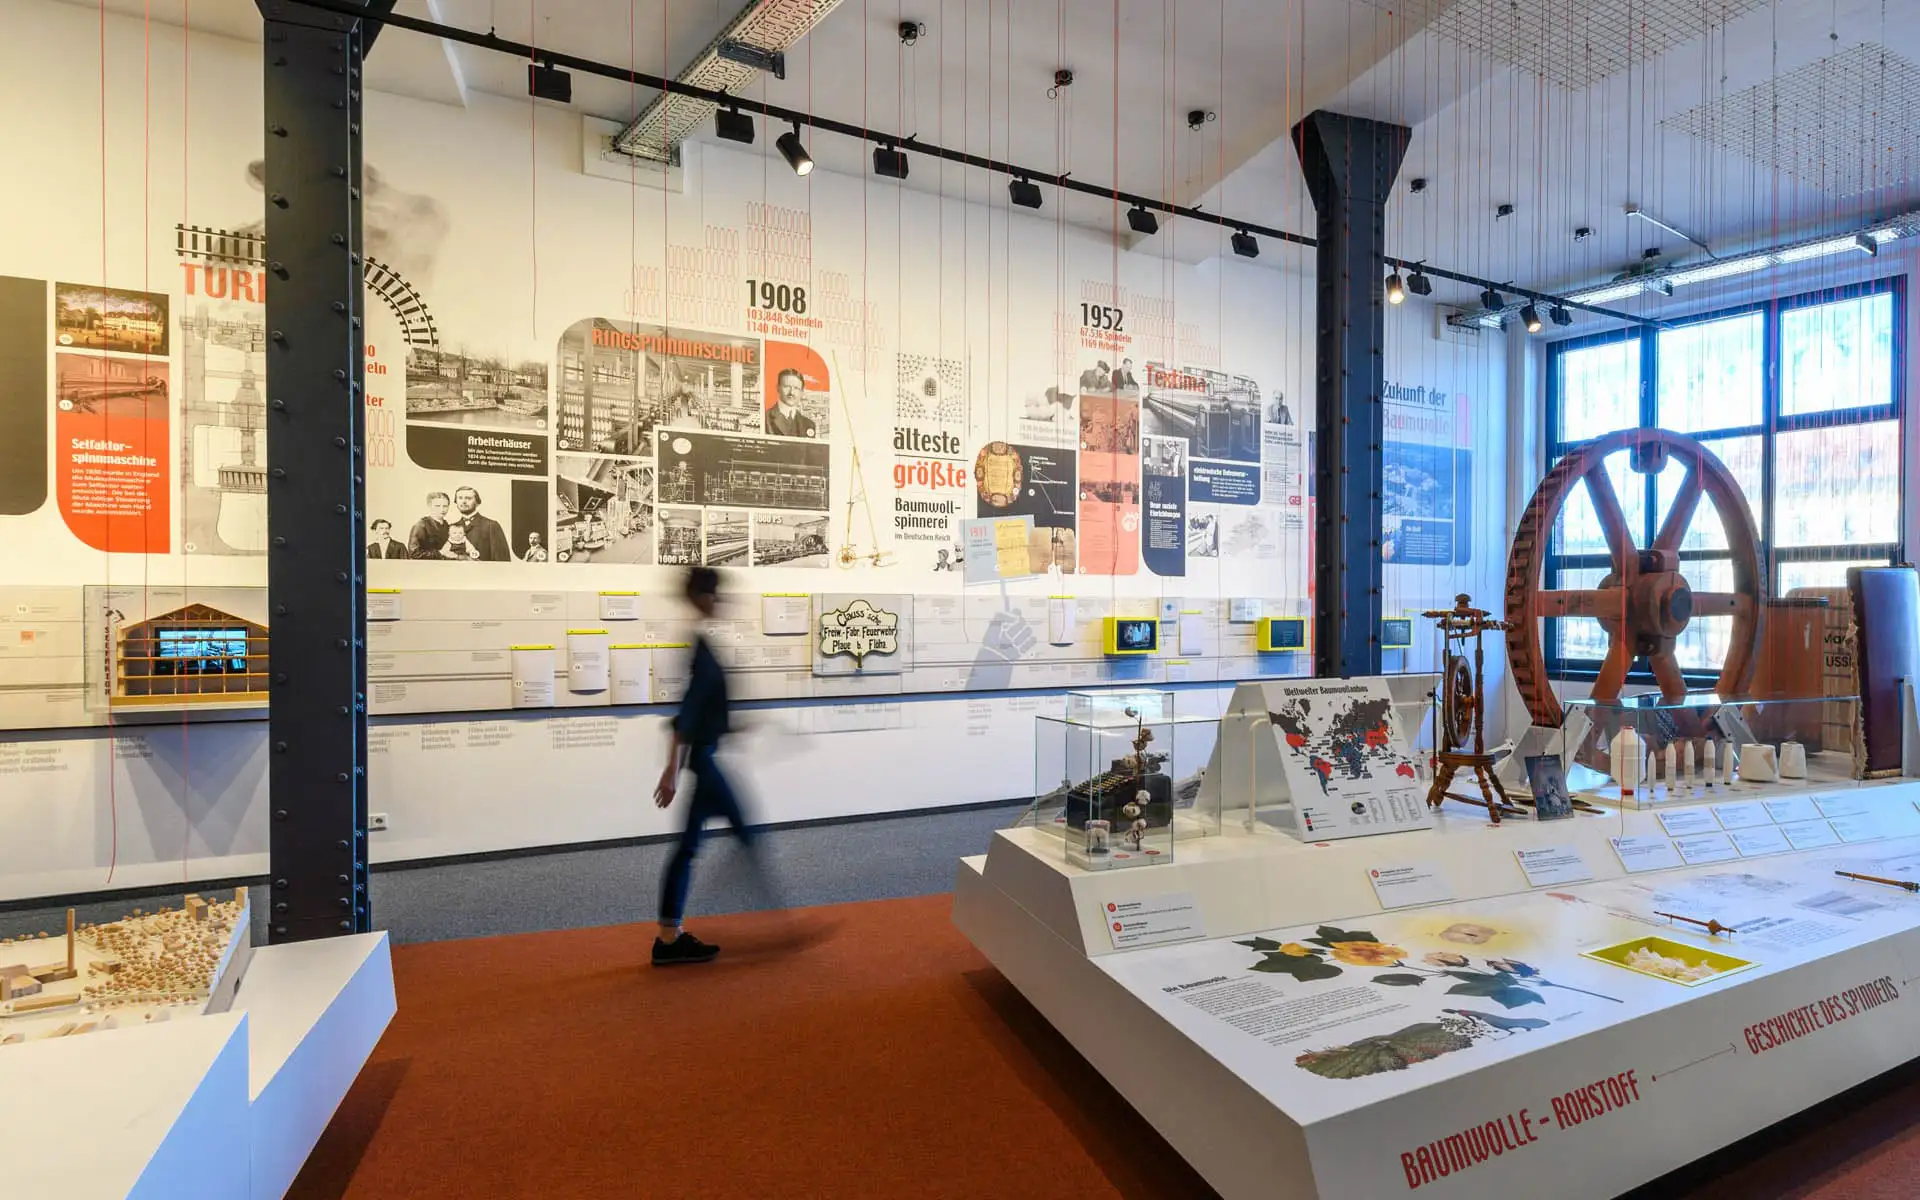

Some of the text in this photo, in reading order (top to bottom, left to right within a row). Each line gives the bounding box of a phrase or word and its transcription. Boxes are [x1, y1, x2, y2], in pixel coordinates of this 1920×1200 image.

[745, 279, 807, 315] 1908
[784, 313, 823, 329] Spindeln
[1080, 302, 1123, 333] 1952
[746, 320, 808, 339] 1140 Arbeiter
[1104, 330, 1132, 344] Spindeln
[1098, 339, 1125, 353] Arbeiter
[1144, 363, 1207, 393] Textima
[1383, 380, 1447, 407] Zukunft der
[72, 438, 133, 452] Selfaktor-
[467, 435, 532, 450] Arbeiterhäuser
[893, 426, 960, 454] älteste
[72, 453, 157, 467] spinnmaschine
[893, 460, 967, 490] größte
[895, 497, 962, 514] Baumwoll-
[894, 514, 948, 529] spinnerei
[904, 533, 934, 542] Deutschen
[935, 534, 951, 542] Reich
[658, 554, 689, 564] 1000 PS
[861, 626, 896, 639] Feuerwehr
[832, 640, 852, 653] Plaue
[1283, 686, 1319, 697] Weltweiter
[1743, 975, 1900, 1055] GESCHICHTE DES SPINNENS
[1400, 1108, 1539, 1190] BAUMWOLLE
[1551, 1068, 1641, 1131] ROHSTOFF
